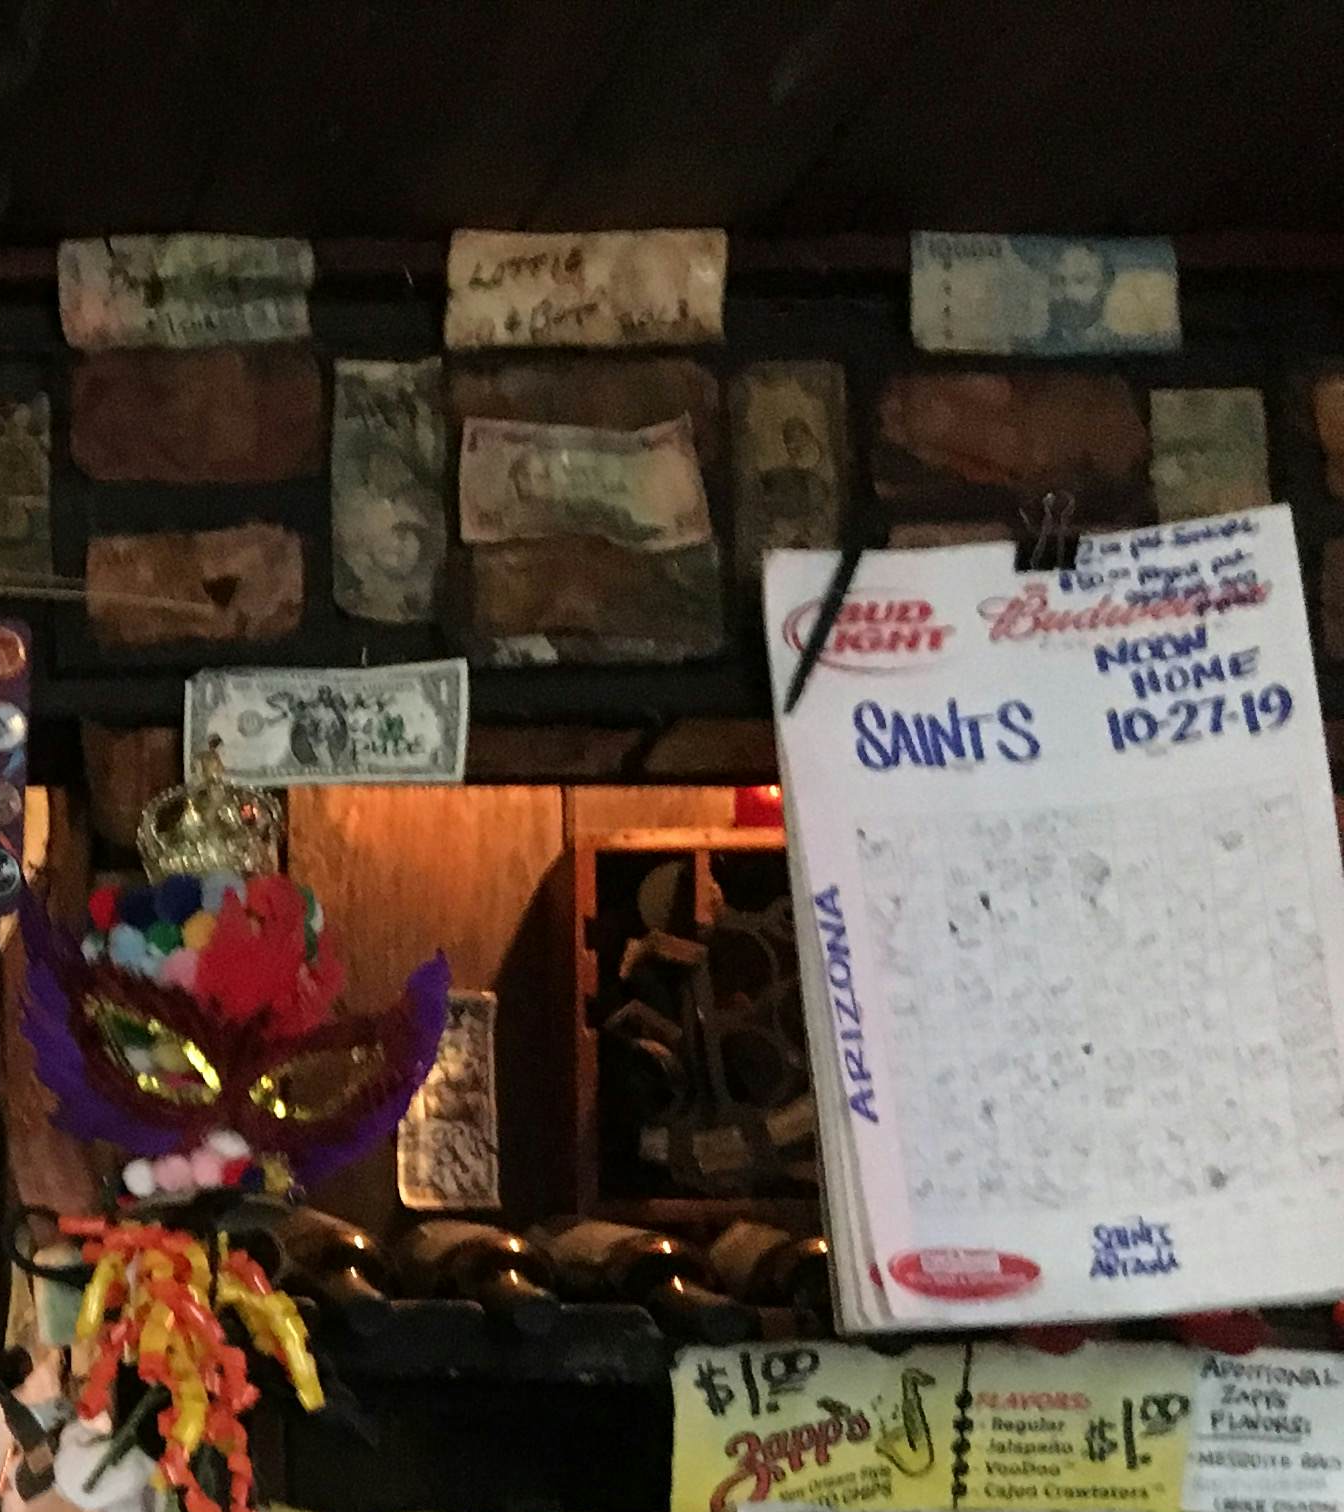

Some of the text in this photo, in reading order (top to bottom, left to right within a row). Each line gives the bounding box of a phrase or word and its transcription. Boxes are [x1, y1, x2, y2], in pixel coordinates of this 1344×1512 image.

[1131, 646, 1260, 699] HOME
[853, 699, 1040, 771] SAINTS
[1106, 683, 1293, 752] 10-27-19
[814, 885, 878, 1123] ARIZONA
[992, 1416, 1066, 1435] Regular
